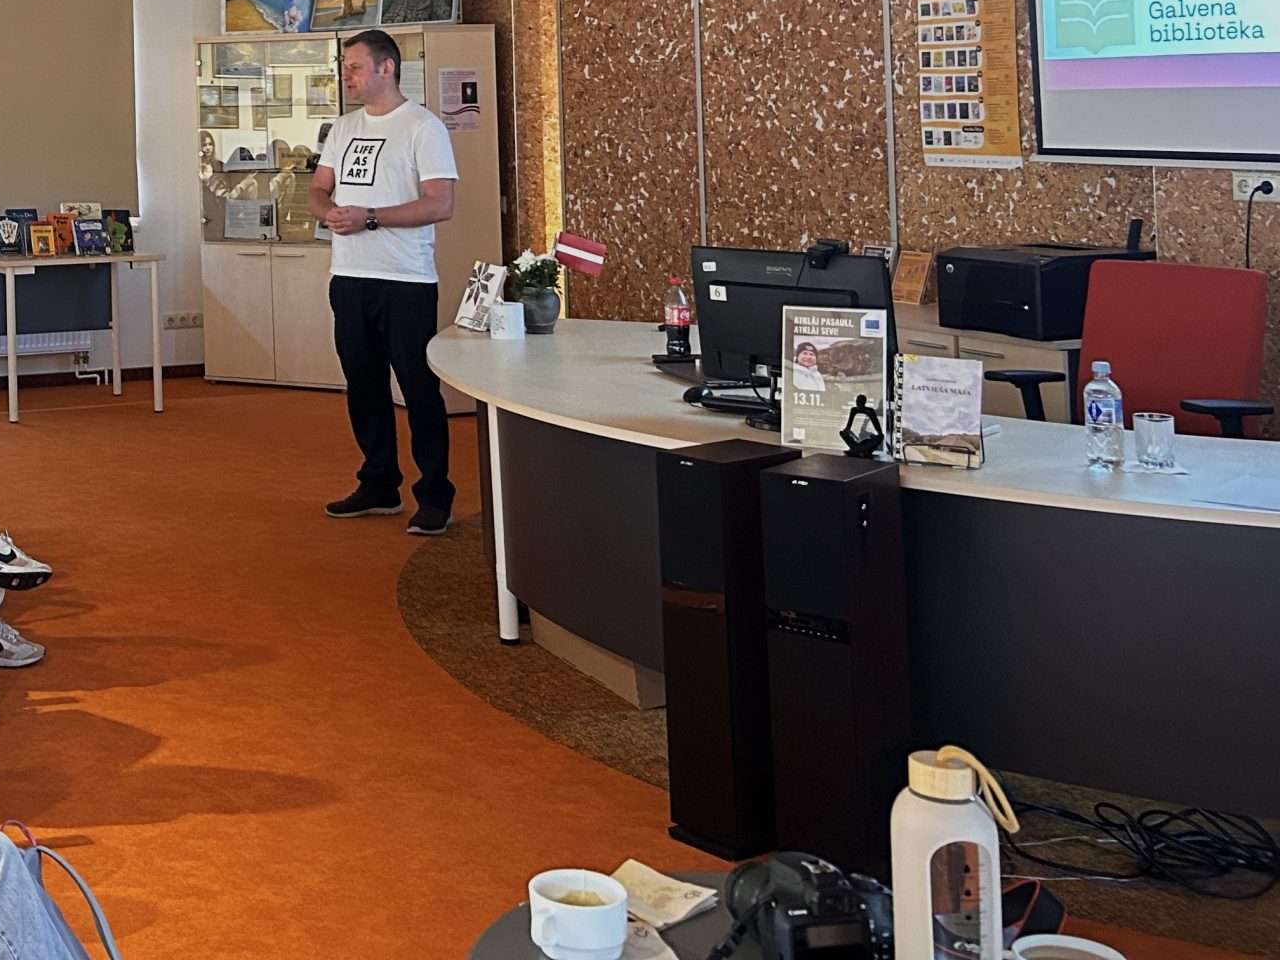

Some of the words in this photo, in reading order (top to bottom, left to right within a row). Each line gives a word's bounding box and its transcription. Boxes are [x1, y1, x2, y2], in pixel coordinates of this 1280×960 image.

[1149, 19, 1265, 43] bibliotēka
[353, 144, 375, 154] LIFE
[352, 156, 368, 166] AS
[347, 168, 368, 178] ART
[714, 287, 721, 298] 6
[793, 315, 820, 325] ATKLĀJ
[793, 326, 820, 335] ATKLĀJ
[792, 392, 825, 407] 13.11.
